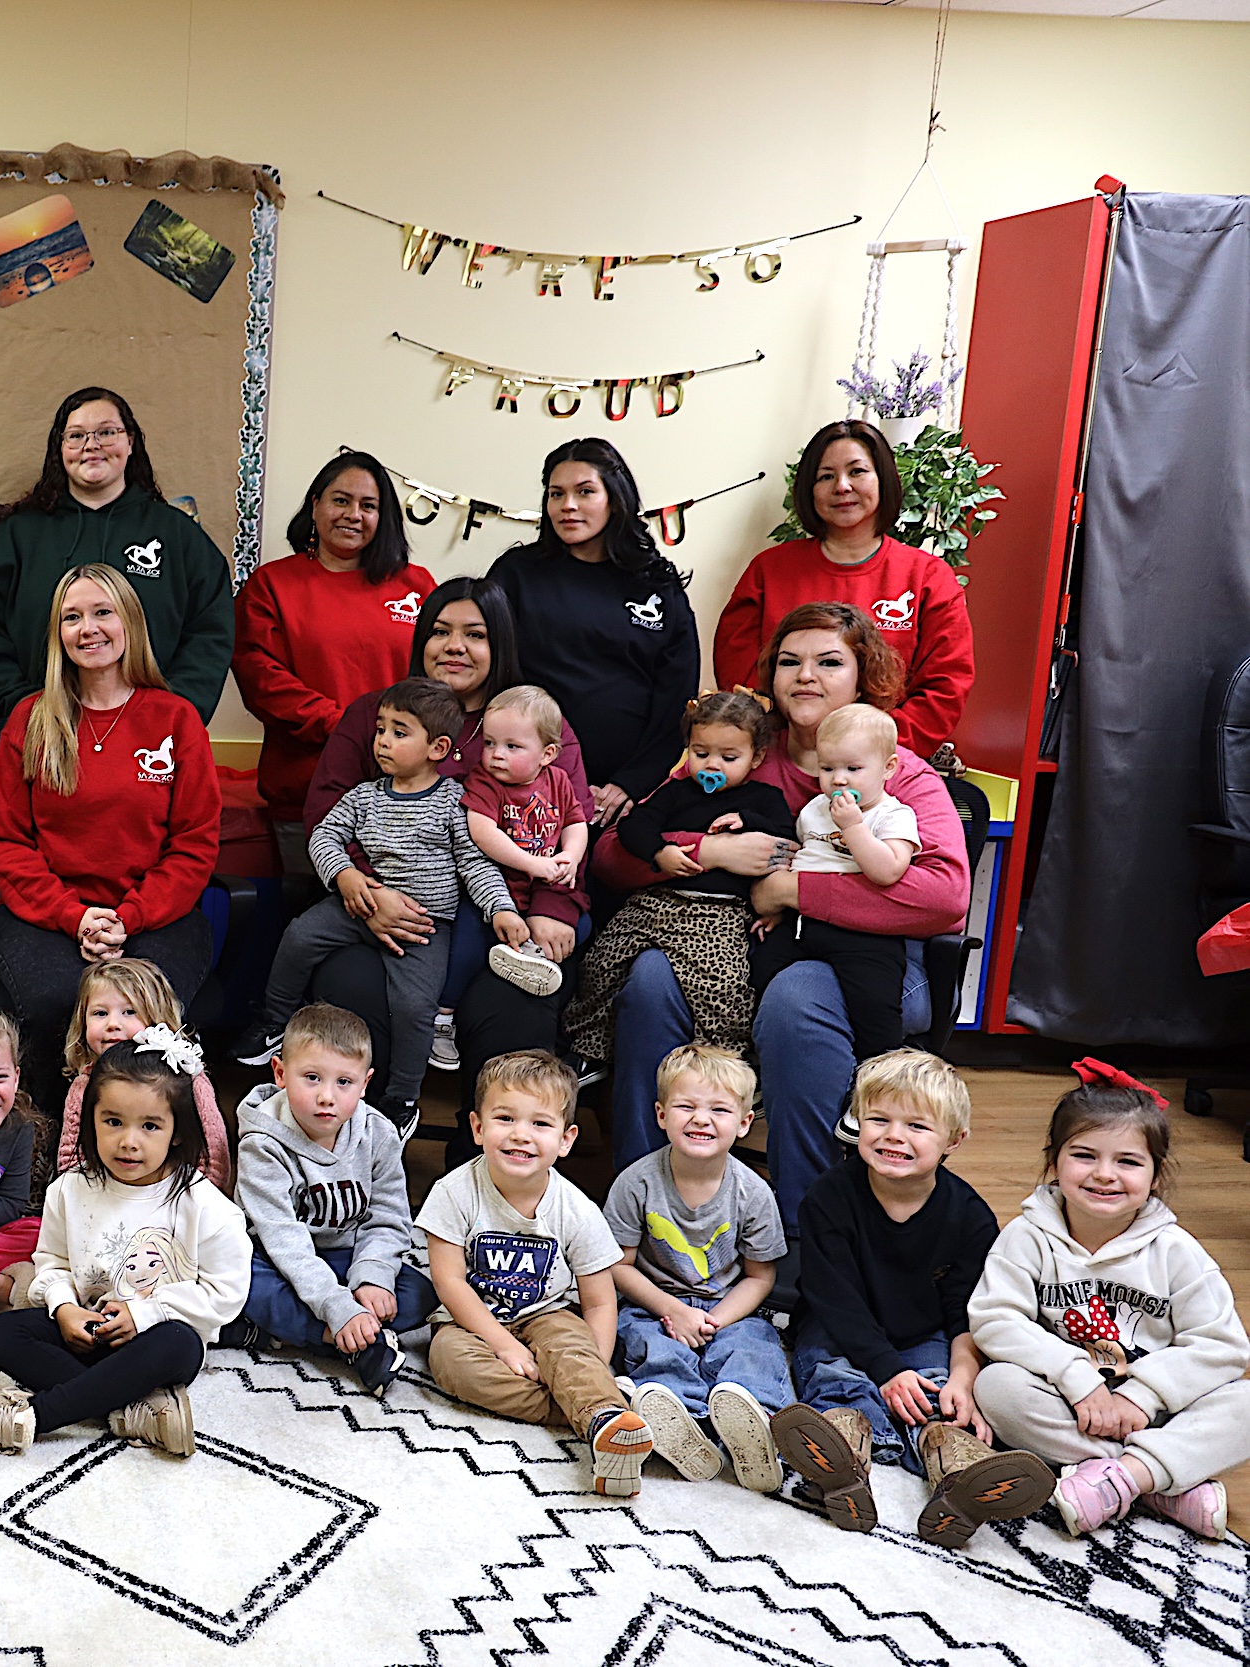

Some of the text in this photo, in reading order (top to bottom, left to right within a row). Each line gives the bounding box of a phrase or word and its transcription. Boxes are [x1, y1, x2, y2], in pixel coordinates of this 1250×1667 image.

[695, 244, 784, 292] SO
[405, 488, 500, 541] OF
[503, 804, 548, 820] SEE YA
[479, 1237, 549, 1250] MOUNT RAINIER
[485, 1249, 537, 1274] WA
[477, 1281, 531, 1300] SINCE
[1094, 1278, 1170, 1319] MOUSE
